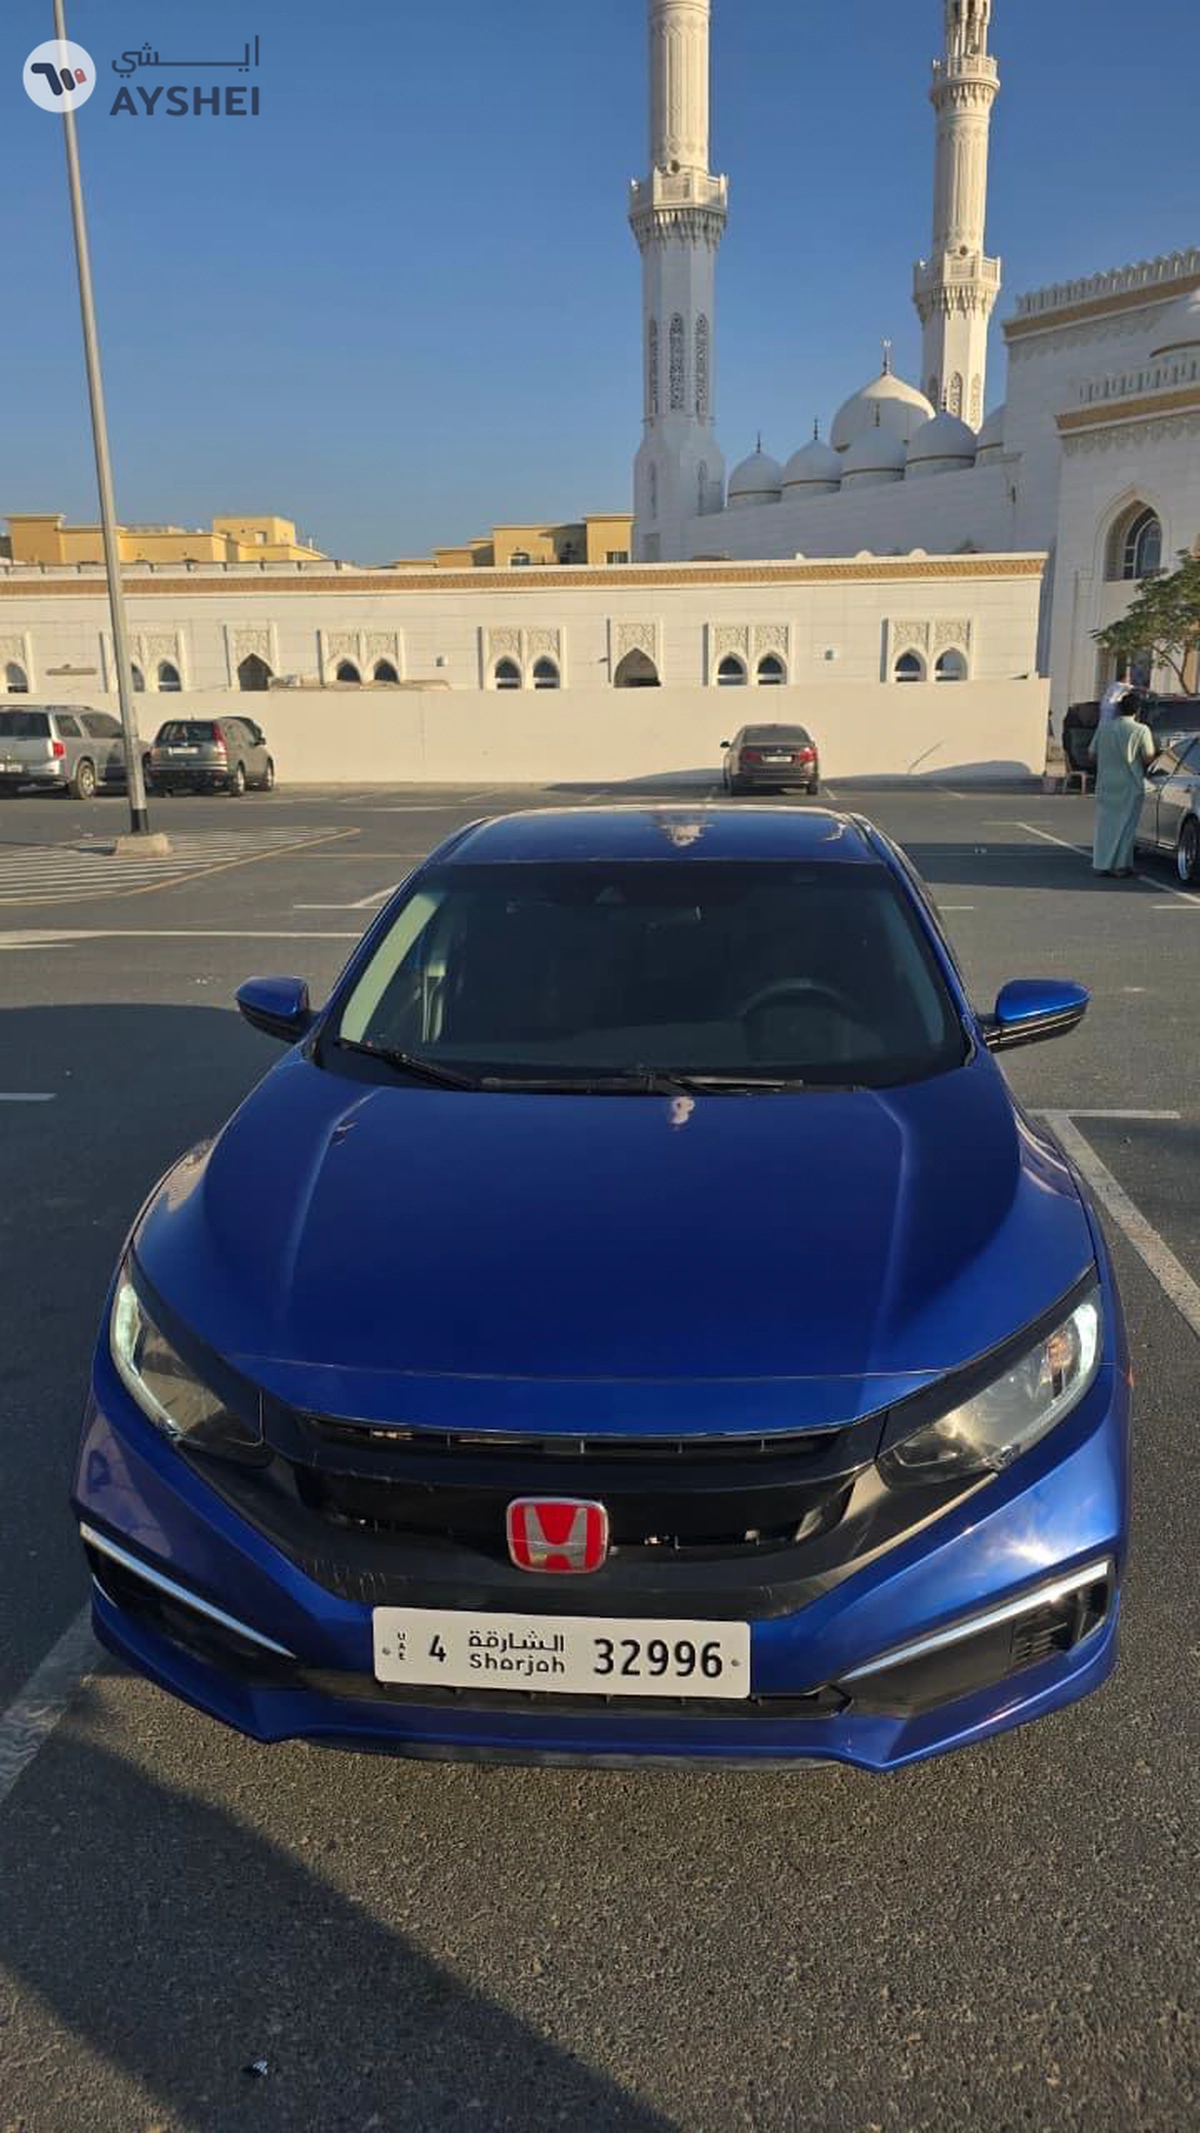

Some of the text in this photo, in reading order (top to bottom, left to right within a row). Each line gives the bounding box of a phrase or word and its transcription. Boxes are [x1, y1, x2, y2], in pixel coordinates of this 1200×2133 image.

[428, 1634, 447, 1663] 4
[468, 1630, 565, 1653] الشارقة
[469, 1652, 565, 1676] Sharjah
[593, 1638, 723, 1678] 32996
